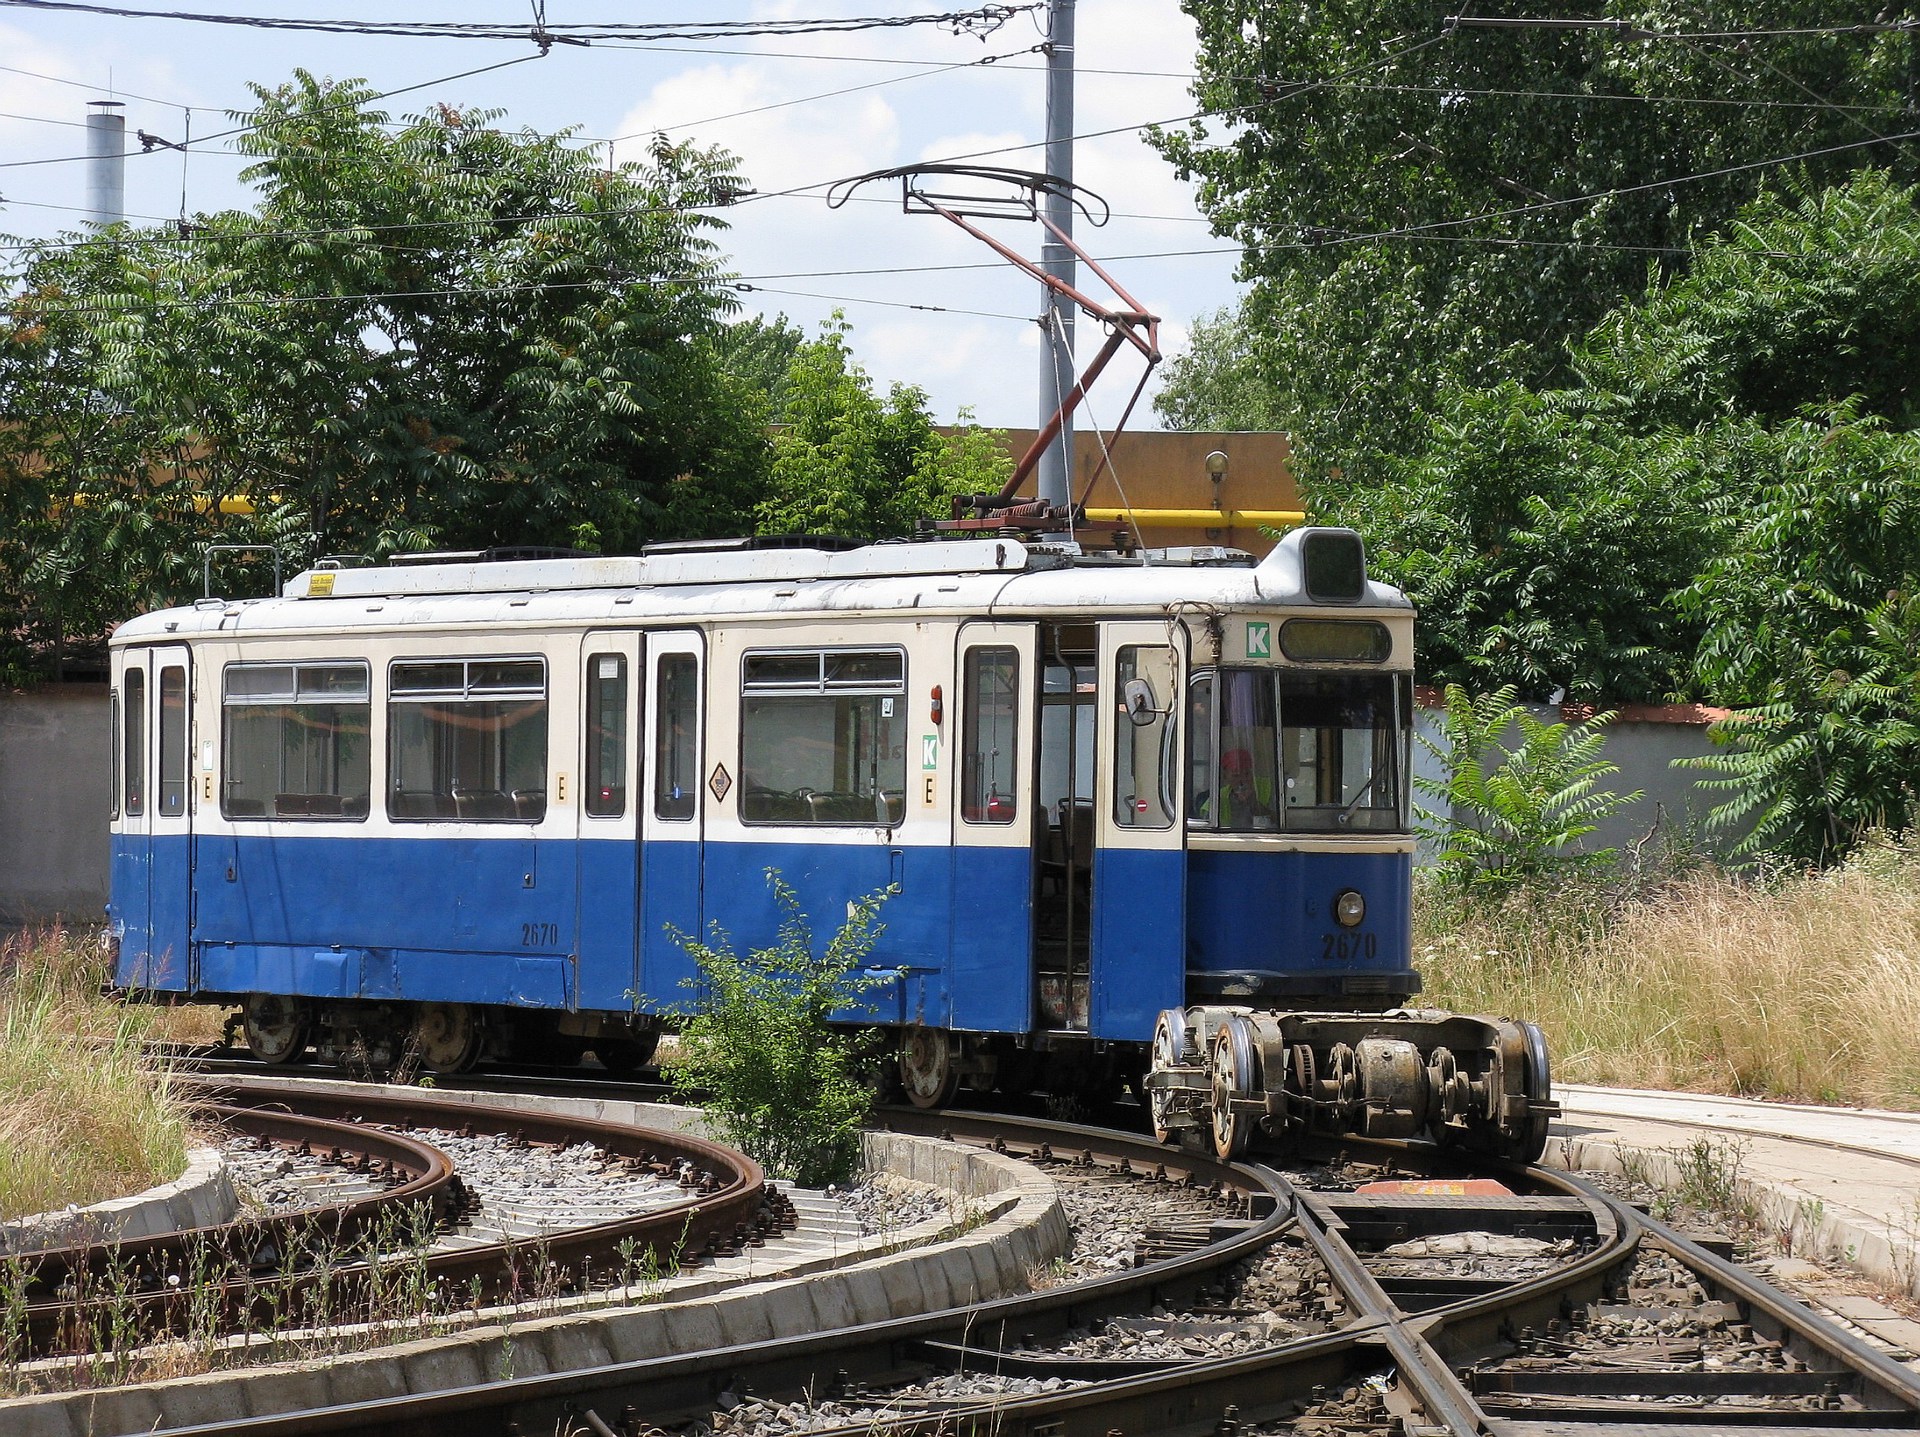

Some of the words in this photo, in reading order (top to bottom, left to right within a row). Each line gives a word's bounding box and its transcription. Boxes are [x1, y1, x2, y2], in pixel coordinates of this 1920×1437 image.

[1249, 626, 1268, 653] K
[923, 739, 937, 765] K
[204, 777, 211, 799] E
[558, 776, 565, 800] E
[925, 778, 933, 803] E
[522, 922, 558, 947] 2670
[1322, 932, 1378, 960] 2670
